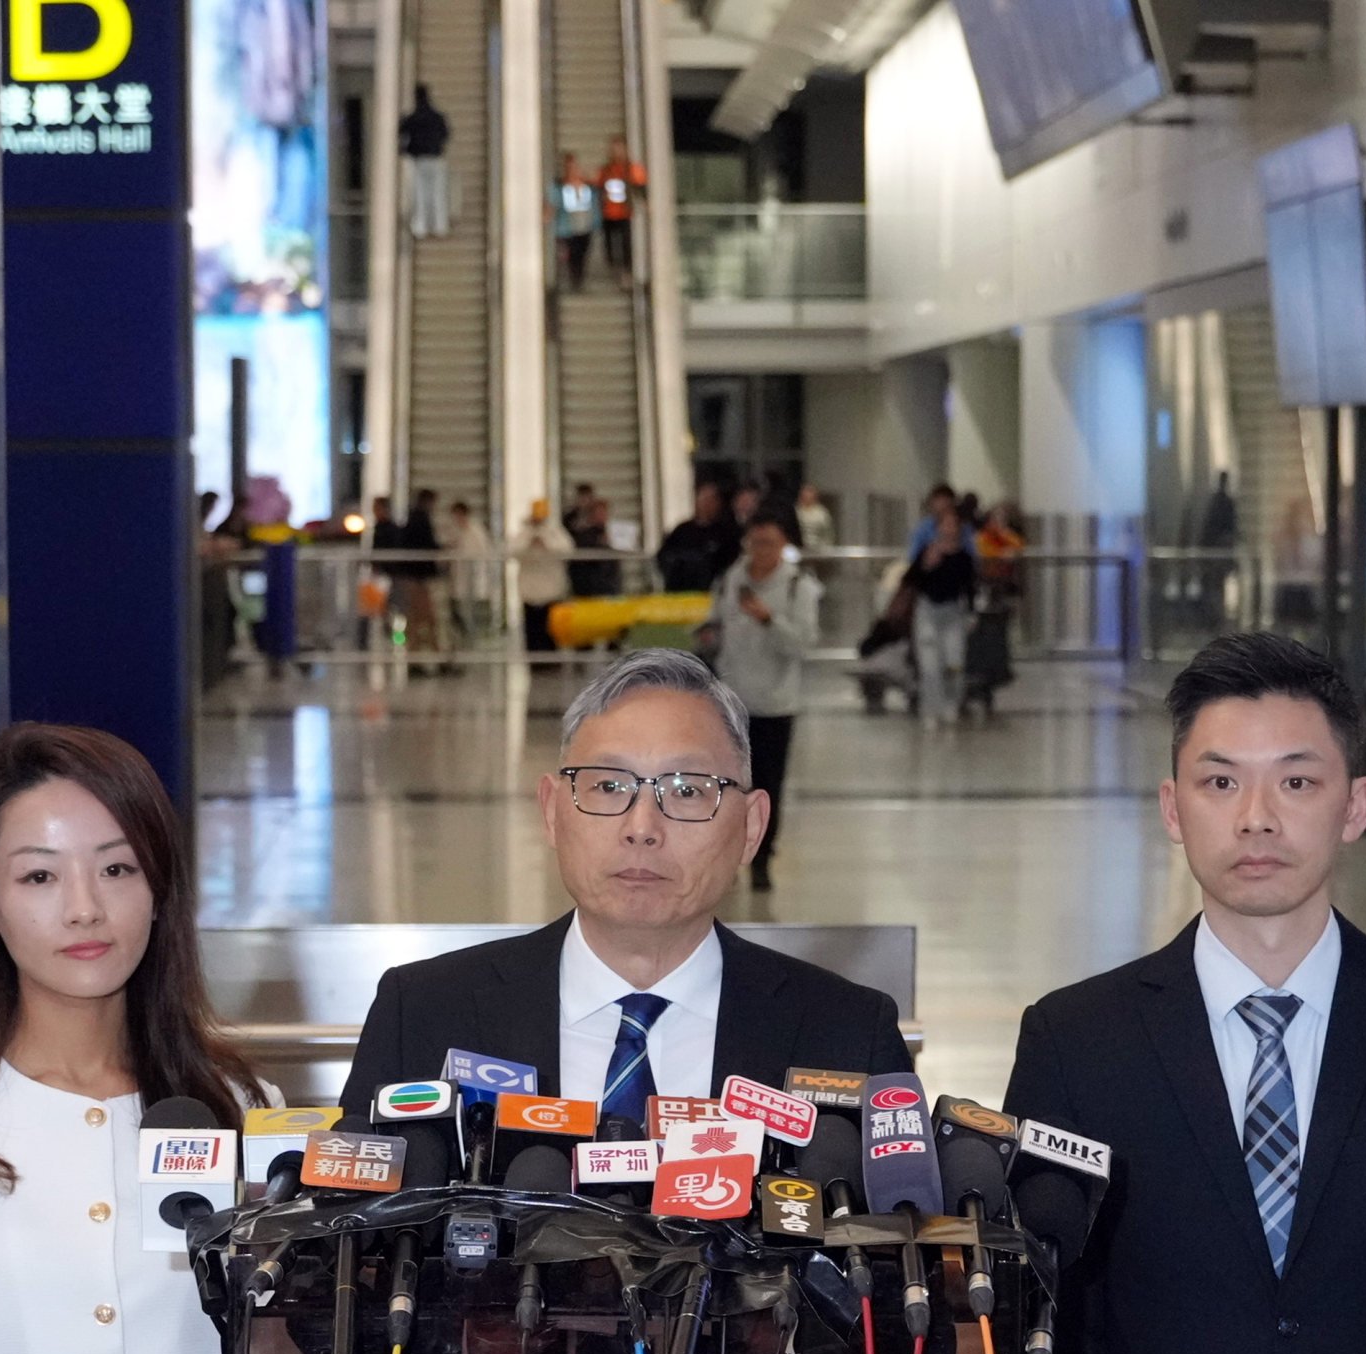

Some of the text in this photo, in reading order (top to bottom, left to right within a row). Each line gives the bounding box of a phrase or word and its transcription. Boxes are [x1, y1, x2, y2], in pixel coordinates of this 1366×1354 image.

[98, 124, 152, 153] Hall
[793, 1073, 861, 1090] now
[658, 1100, 722, 1118] 巴士
[736, 1085, 806, 1117] RTHK
[730, 1099, 805, 1133] 香港電台
[870, 1109, 922, 1125] 有線
[871, 1121, 924, 1139] 新聞
[165, 1140, 209, 1156] 星島
[316, 1137, 393, 1162] 全民
[589, 1149, 647, 1159] SZMG
[874, 1142, 914, 1157] HOY
[1030, 1127, 1104, 1164] TMHK
[163, 1155, 207, 1171] 頭條
[313, 1158, 389, 1182] 新聞
[590, 1158, 649, 1173] 深圳
